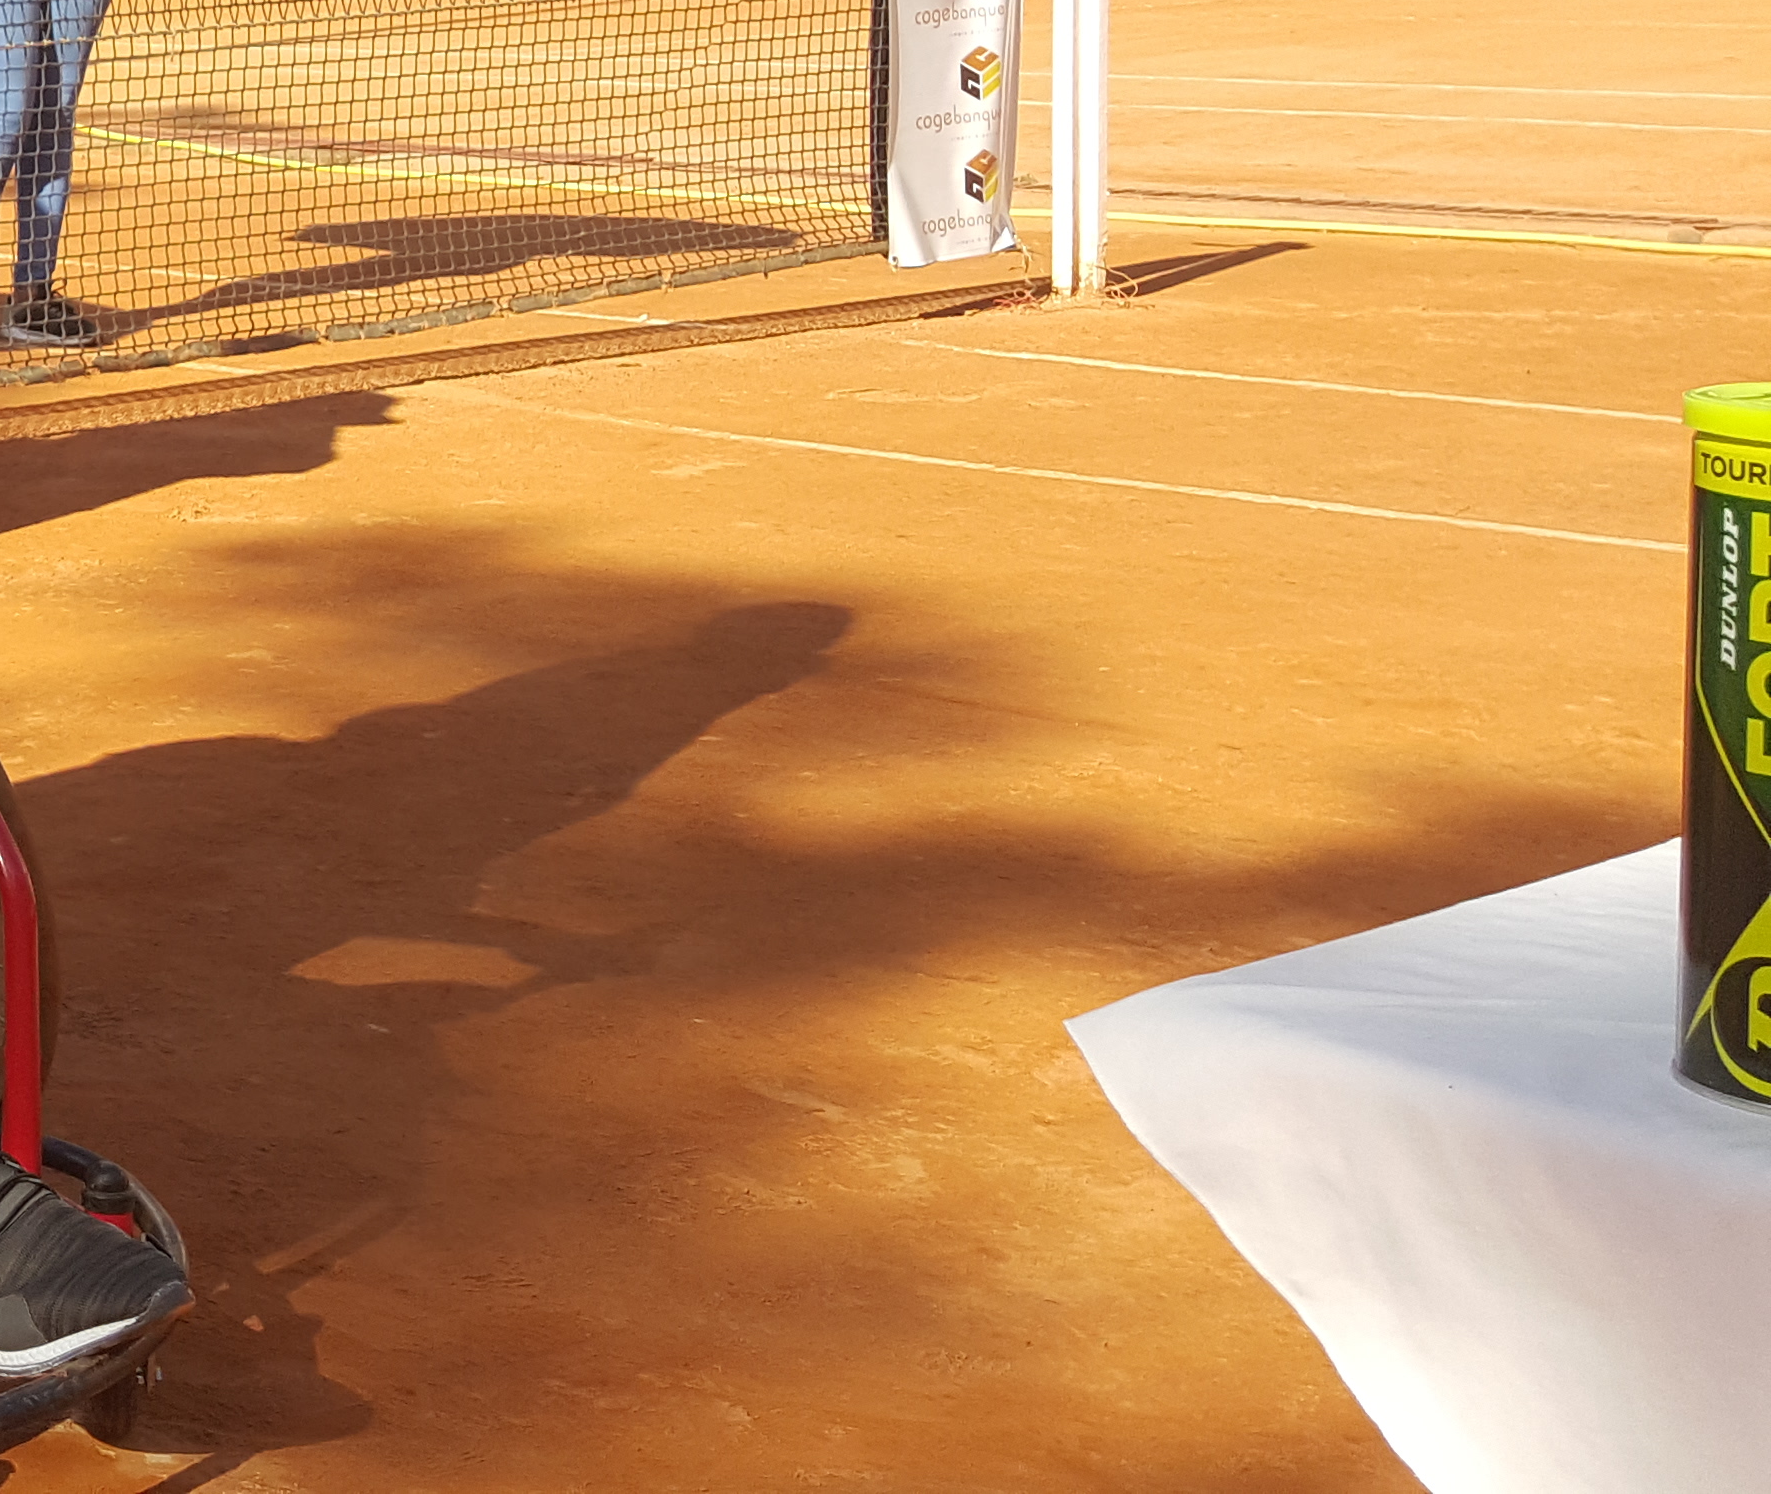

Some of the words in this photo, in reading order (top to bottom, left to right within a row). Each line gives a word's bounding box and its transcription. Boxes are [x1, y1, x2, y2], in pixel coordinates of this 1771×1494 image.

[915, 1, 1006, 29] cogebanque
[915, 104, 1001, 134] cogebanqu
[922, 208, 993, 238] cogebanq
[1700, 451, 1771, 486] TOUR
[1719, 501, 1740, 673] DUNLOP
